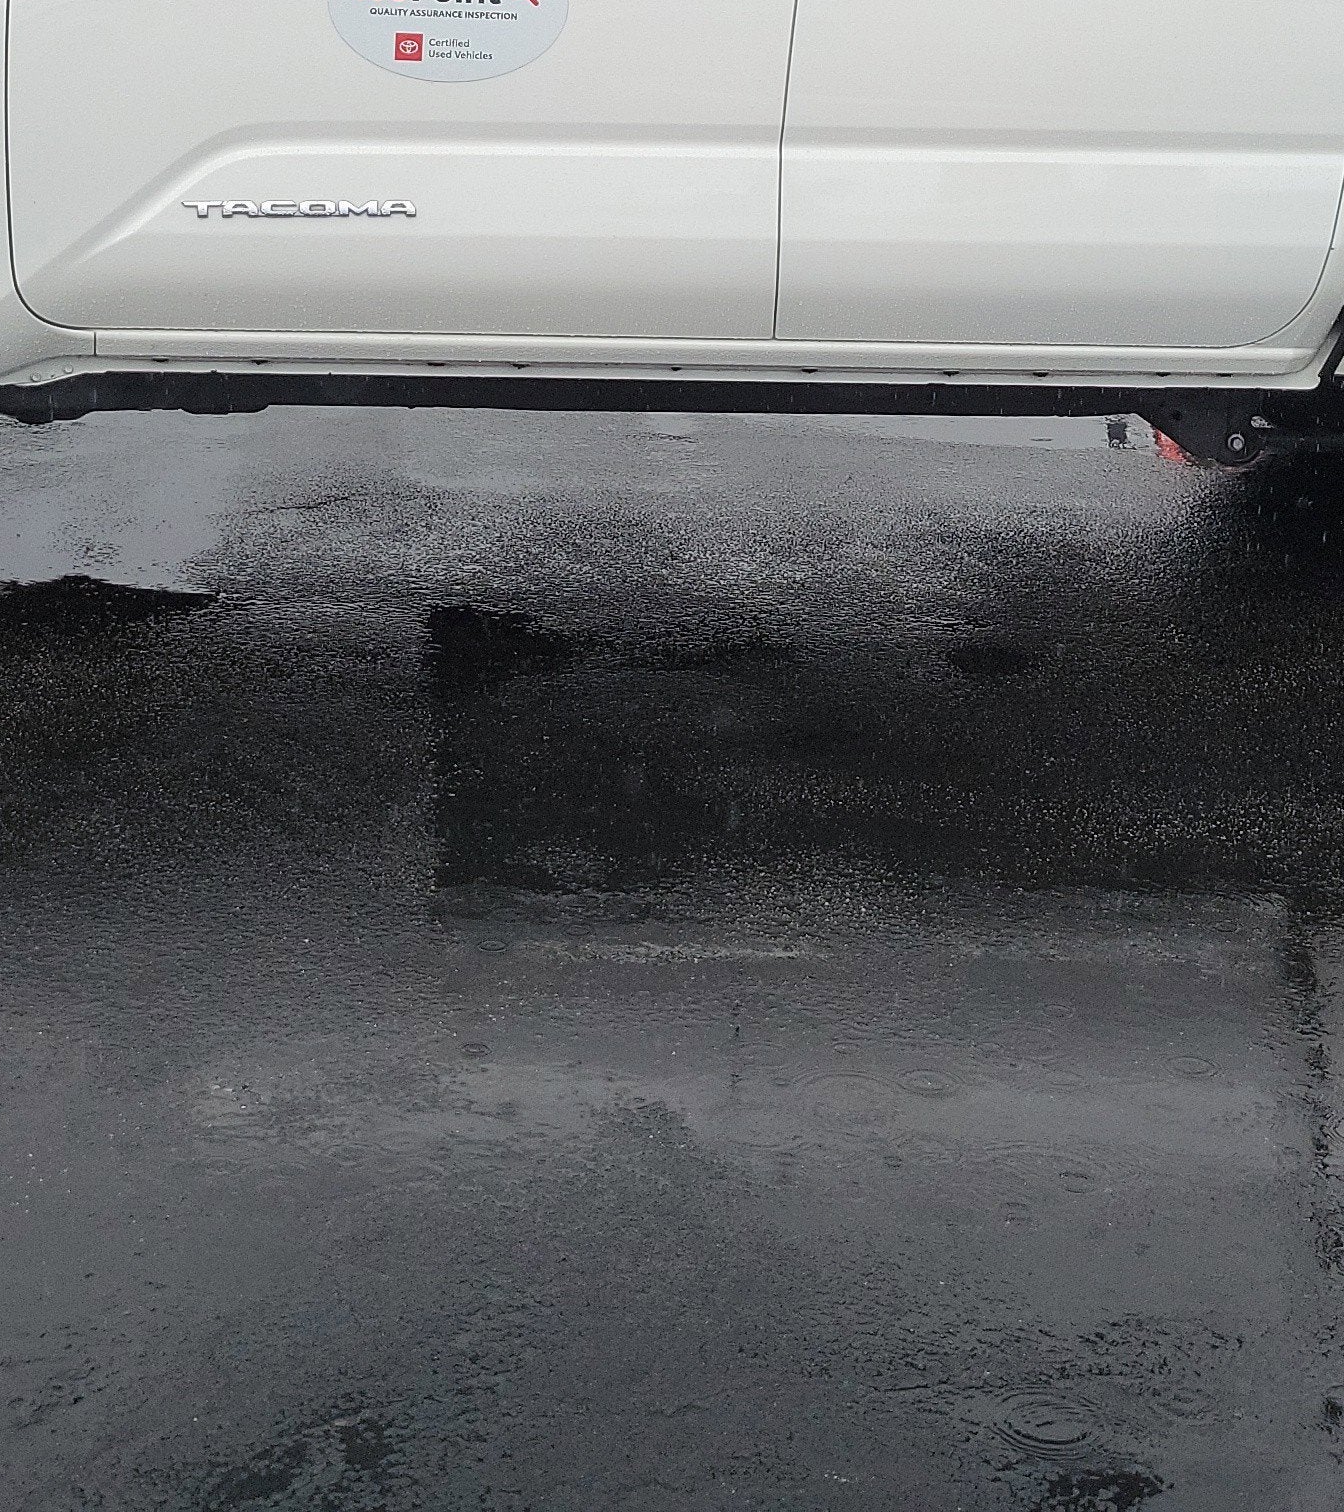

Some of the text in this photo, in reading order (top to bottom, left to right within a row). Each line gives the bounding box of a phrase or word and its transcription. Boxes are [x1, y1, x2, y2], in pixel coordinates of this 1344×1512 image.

[369, 7, 518, 21] QUALITY ASSURANCE INSPECTION
[428, 38, 470, 48] Certified
[428, 50, 493, 60] Used Vehicles
[181, 199, 417, 218] TACOMA
